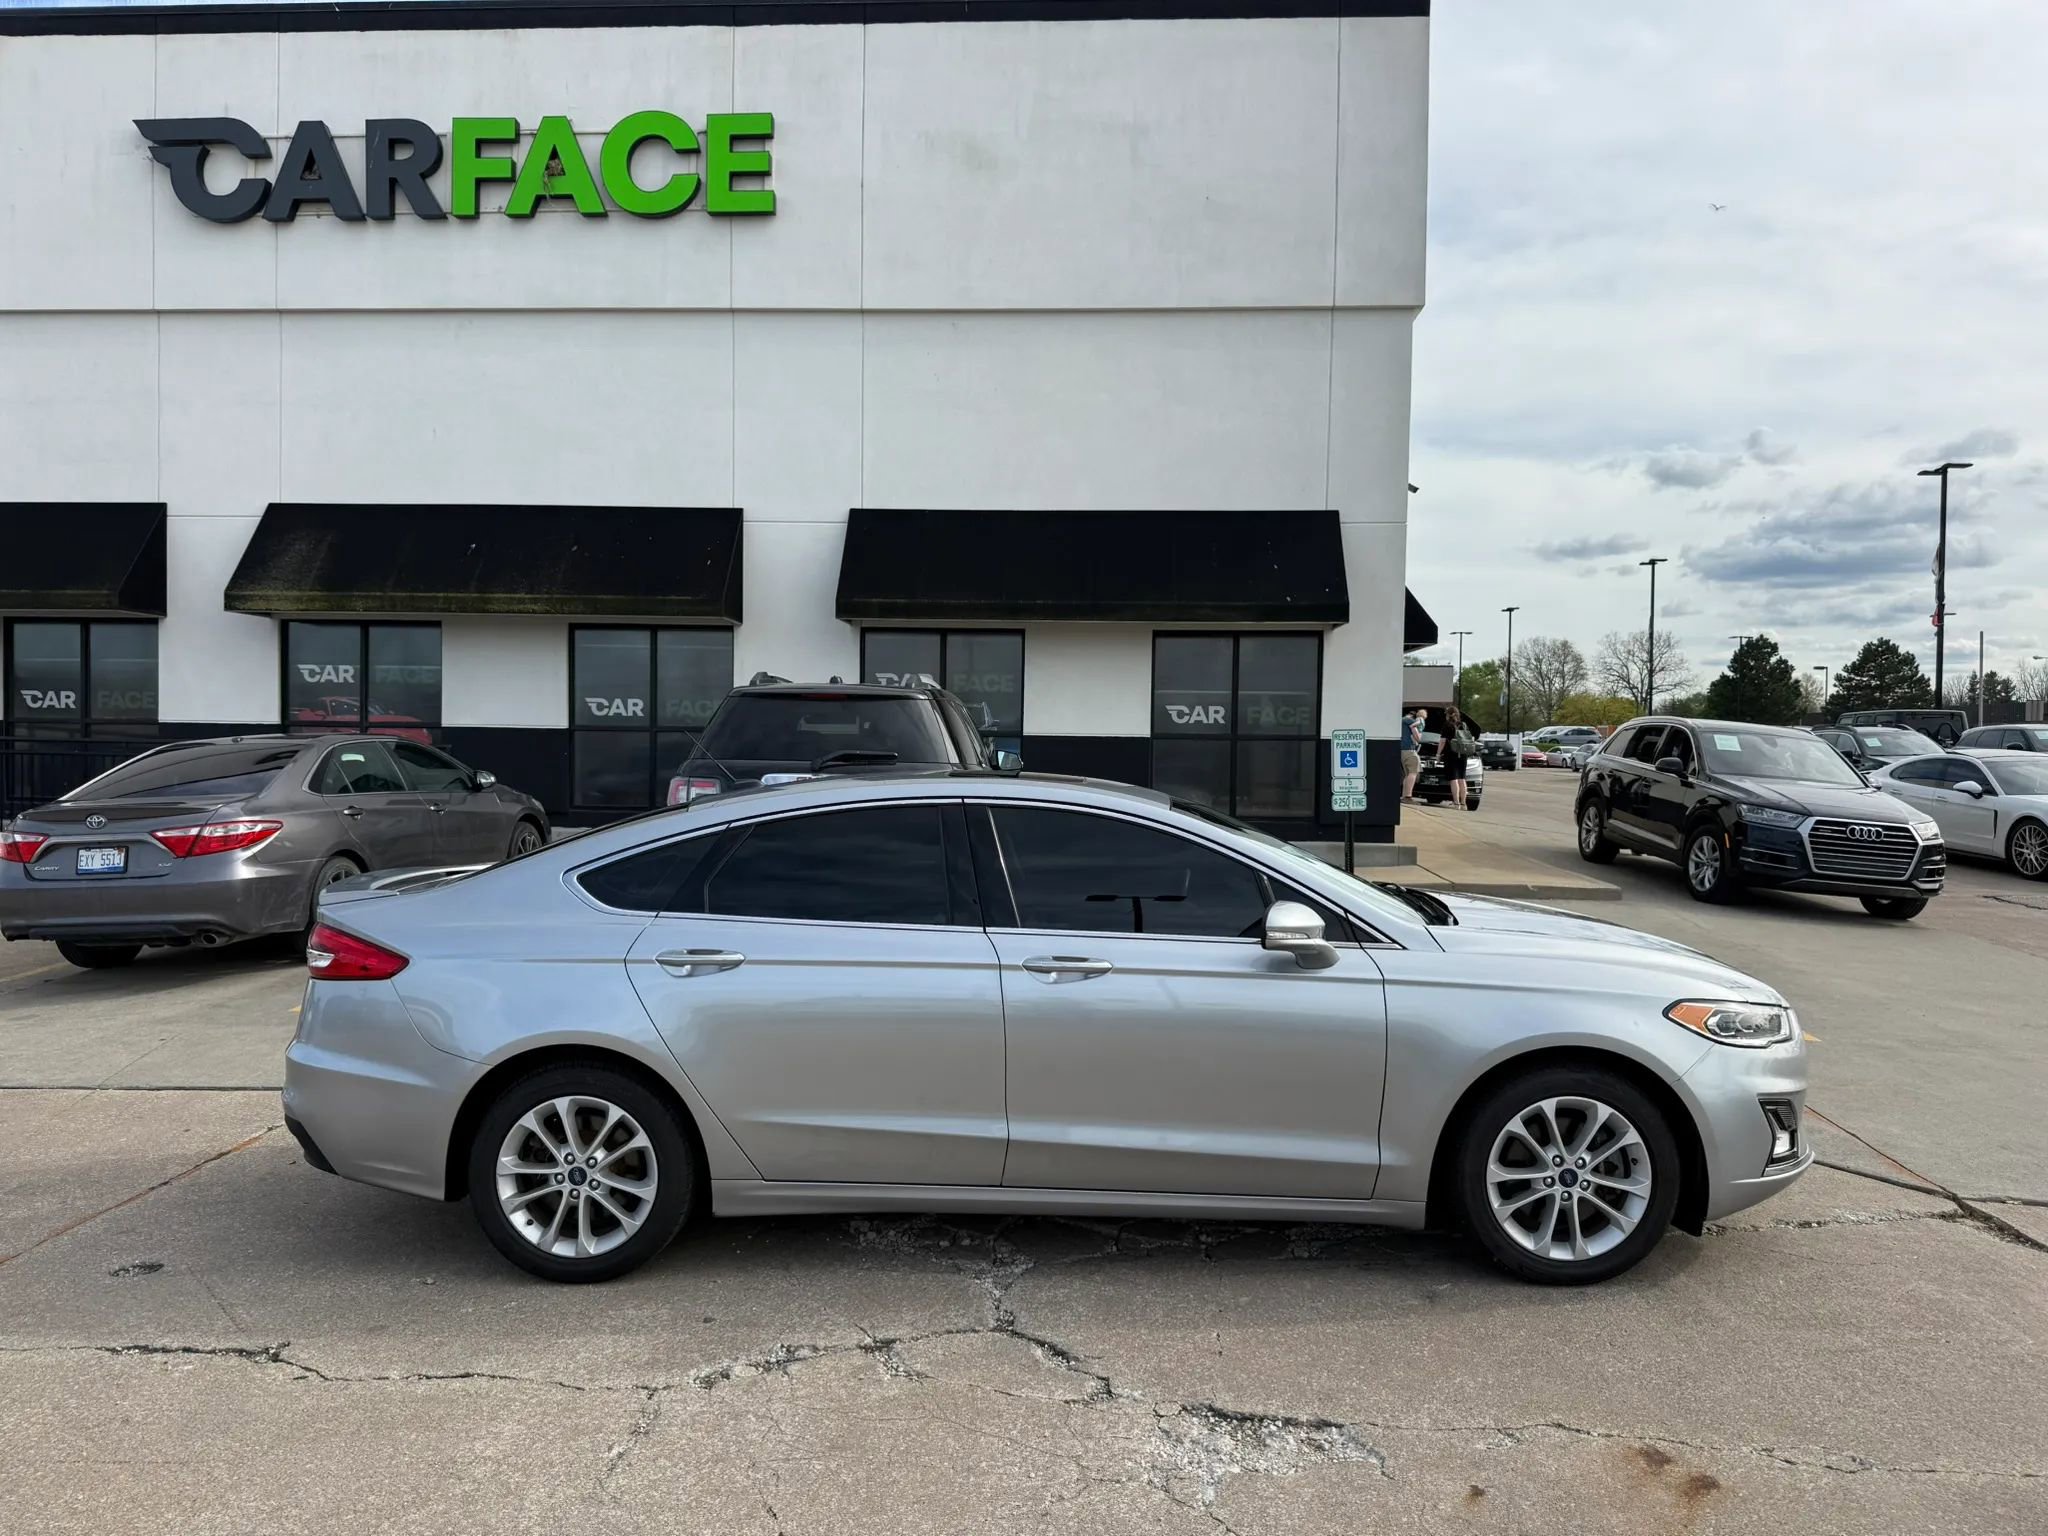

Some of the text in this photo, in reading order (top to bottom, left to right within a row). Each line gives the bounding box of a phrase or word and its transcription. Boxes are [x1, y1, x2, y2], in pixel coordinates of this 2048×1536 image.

[132, 110, 776, 222] CARFACE
[297, 664, 435, 684] CAR FACE
[952, 673, 1014, 692] FACE
[20, 689, 155, 709] CAR FACE
[584, 697, 644, 716] CAR
[1165, 705, 1310, 725] CAR FACE
[1333, 797, 1366, 808] $250 FINE
[79, 853, 95, 867] EXY
